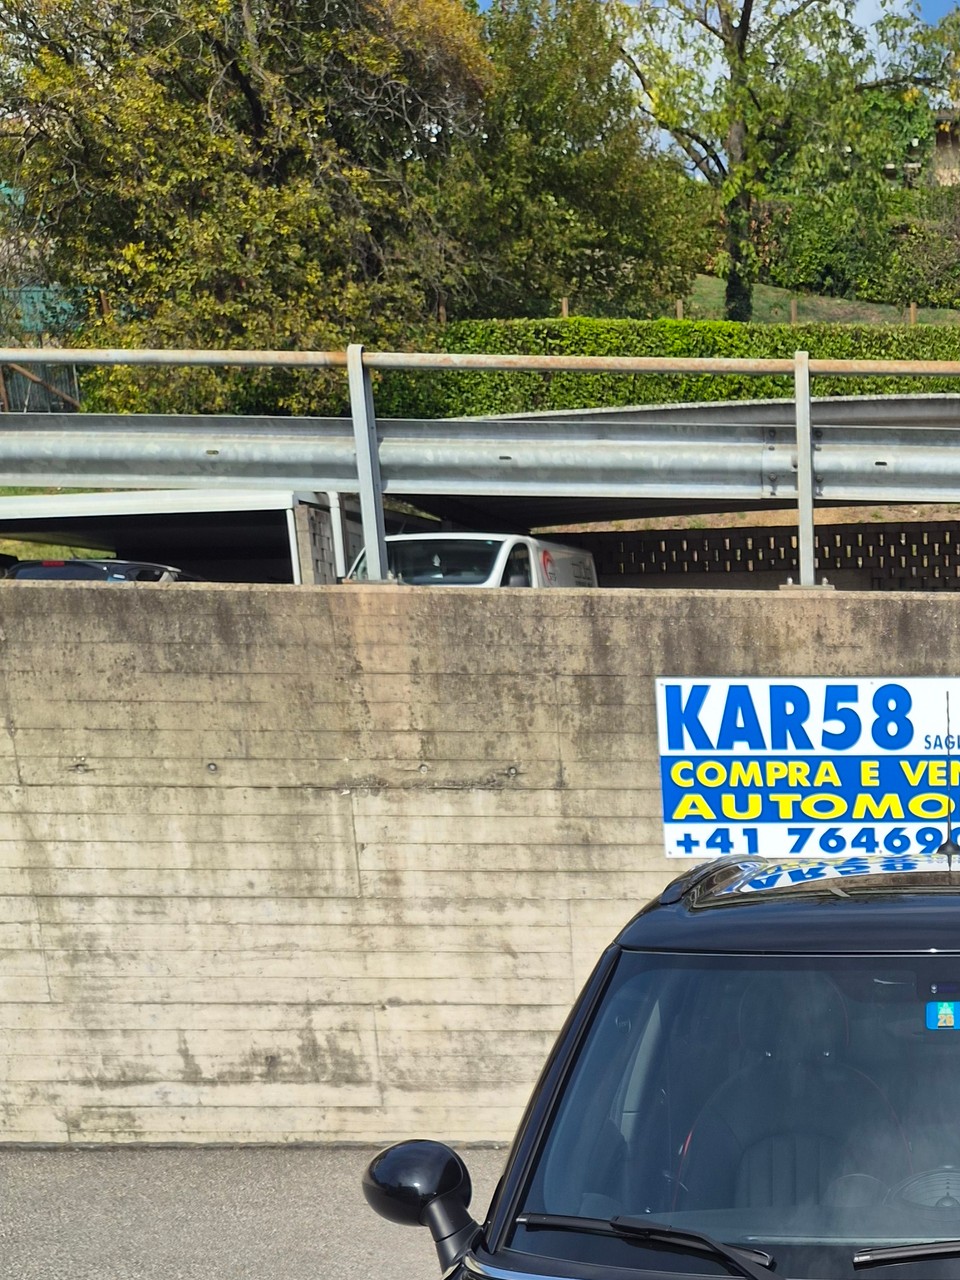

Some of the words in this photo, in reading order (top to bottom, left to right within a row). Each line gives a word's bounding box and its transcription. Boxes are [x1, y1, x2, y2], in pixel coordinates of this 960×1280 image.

[665, 683, 915, 751] KAR58
[670, 761, 841, 787] COMPRA
[861, 761, 880, 786] E
[676, 828, 760, 854] +41
